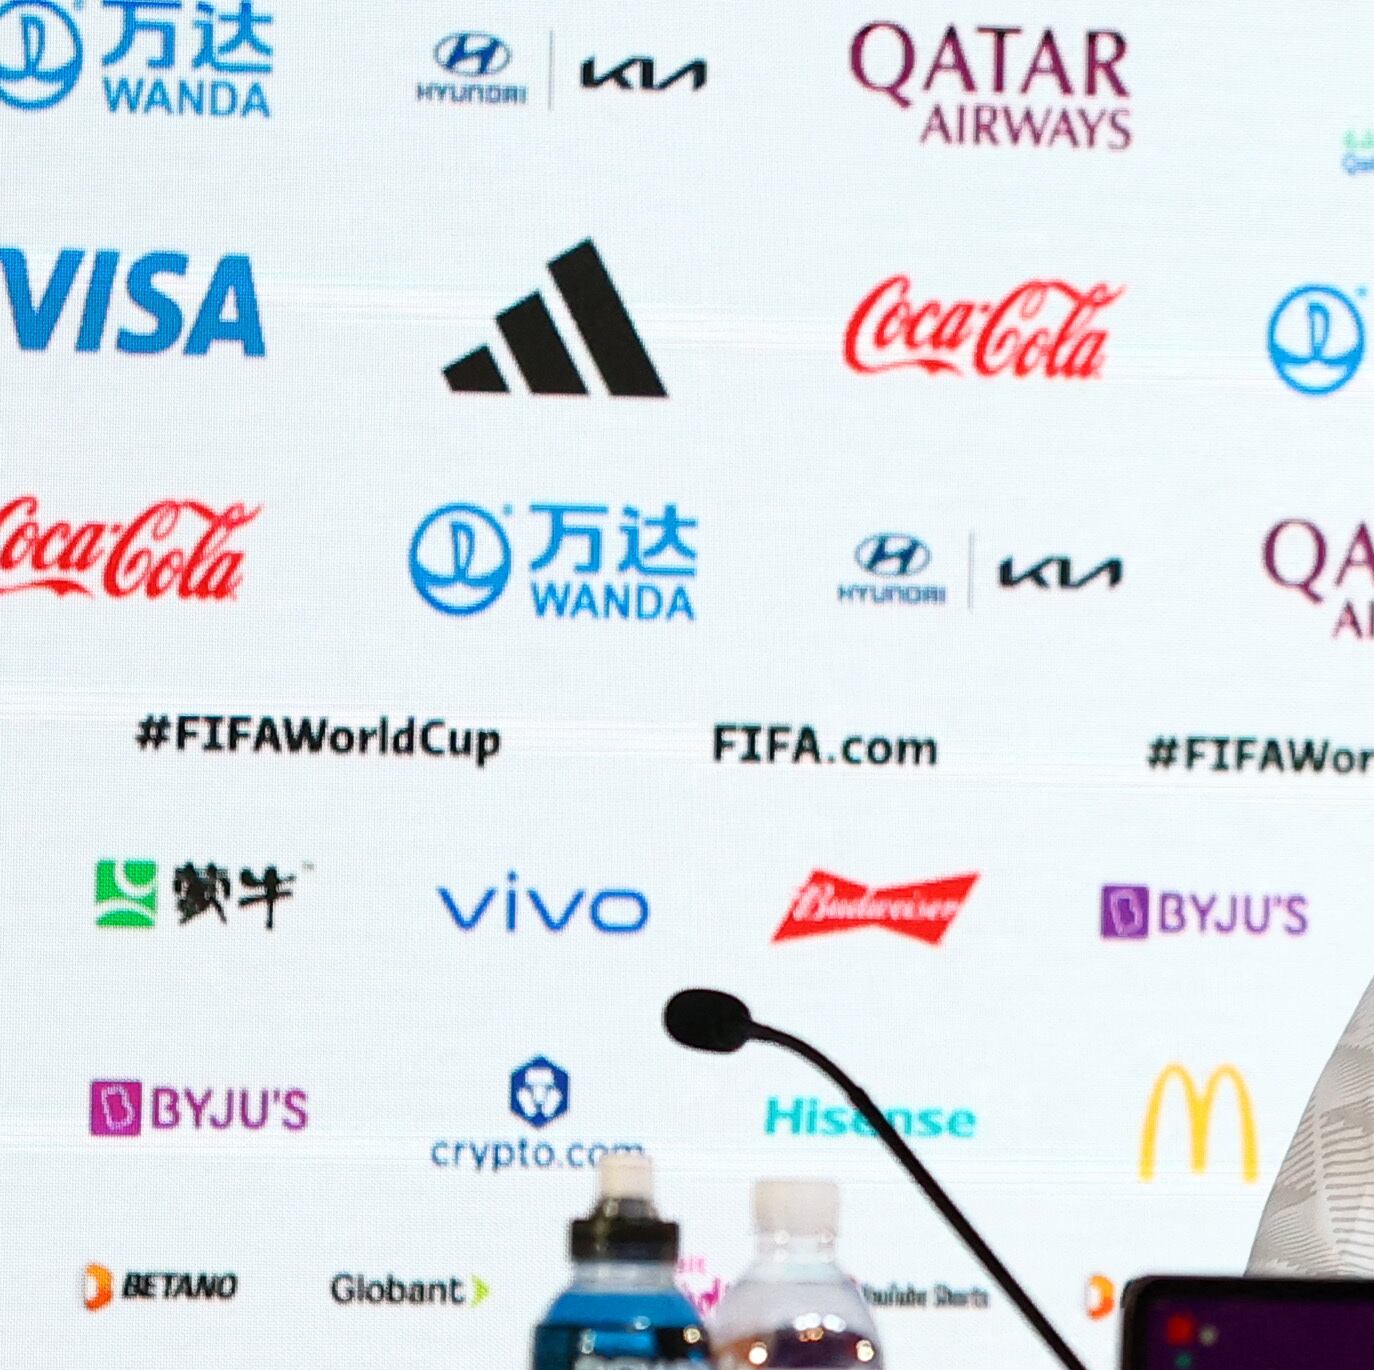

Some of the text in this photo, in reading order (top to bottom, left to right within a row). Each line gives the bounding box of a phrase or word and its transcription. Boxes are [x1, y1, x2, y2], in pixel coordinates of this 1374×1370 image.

[101, 0, 273, 74] 万达
[849, 21, 1129, 109] QATAR
[102, 77, 270, 118] WANDA
[416, 83, 527, 104] HYUNDAI
[921, 104, 1131, 149] AIRWAYS
[0, 247, 266, 358] VISA
[843, 275, 1122, 379] Coca-Cola
[529, 503, 698, 577] 万达
[531, 581, 694, 620] WANDA
[837, 584, 946, 605] HYUNDAI
[135, 715, 500, 768] #FIFAWorldCup
[714, 723, 937, 765] FIFA.com
[437, 870, 650, 934] vivo
[791, 884, 957, 923] Budweiser
[1158, 891, 1308, 936] BYJU'S
[151, 1086, 308, 1131] BYJU'S
[764, 1096, 976, 1138] Hisense
[122, 1272, 238, 1300] BETANO
[330, 1273, 465, 1305] Globant
